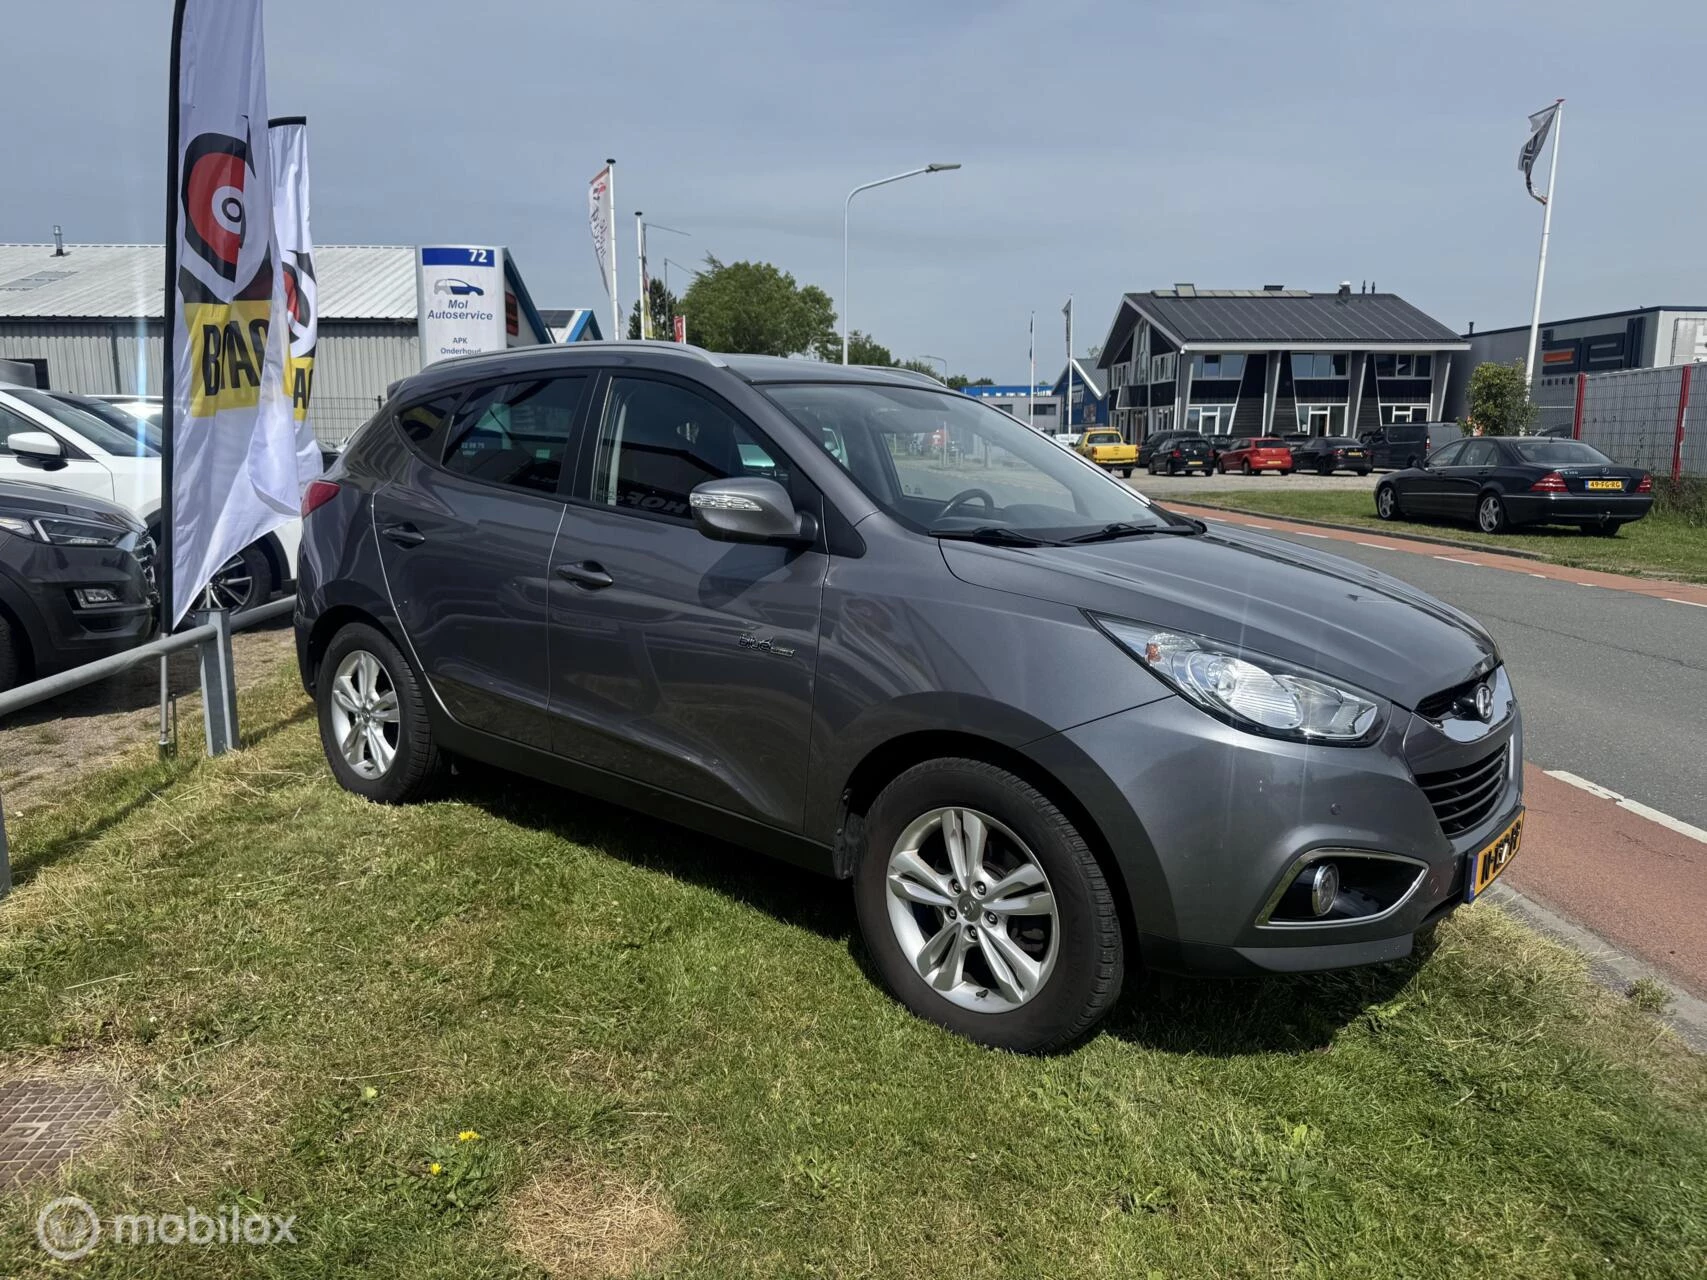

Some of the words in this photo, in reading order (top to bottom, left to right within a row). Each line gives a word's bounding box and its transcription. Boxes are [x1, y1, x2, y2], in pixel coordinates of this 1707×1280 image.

[469, 249, 487, 262] 72
[448, 300, 468, 309] Mol
[428, 310, 493, 320] Autoservice
